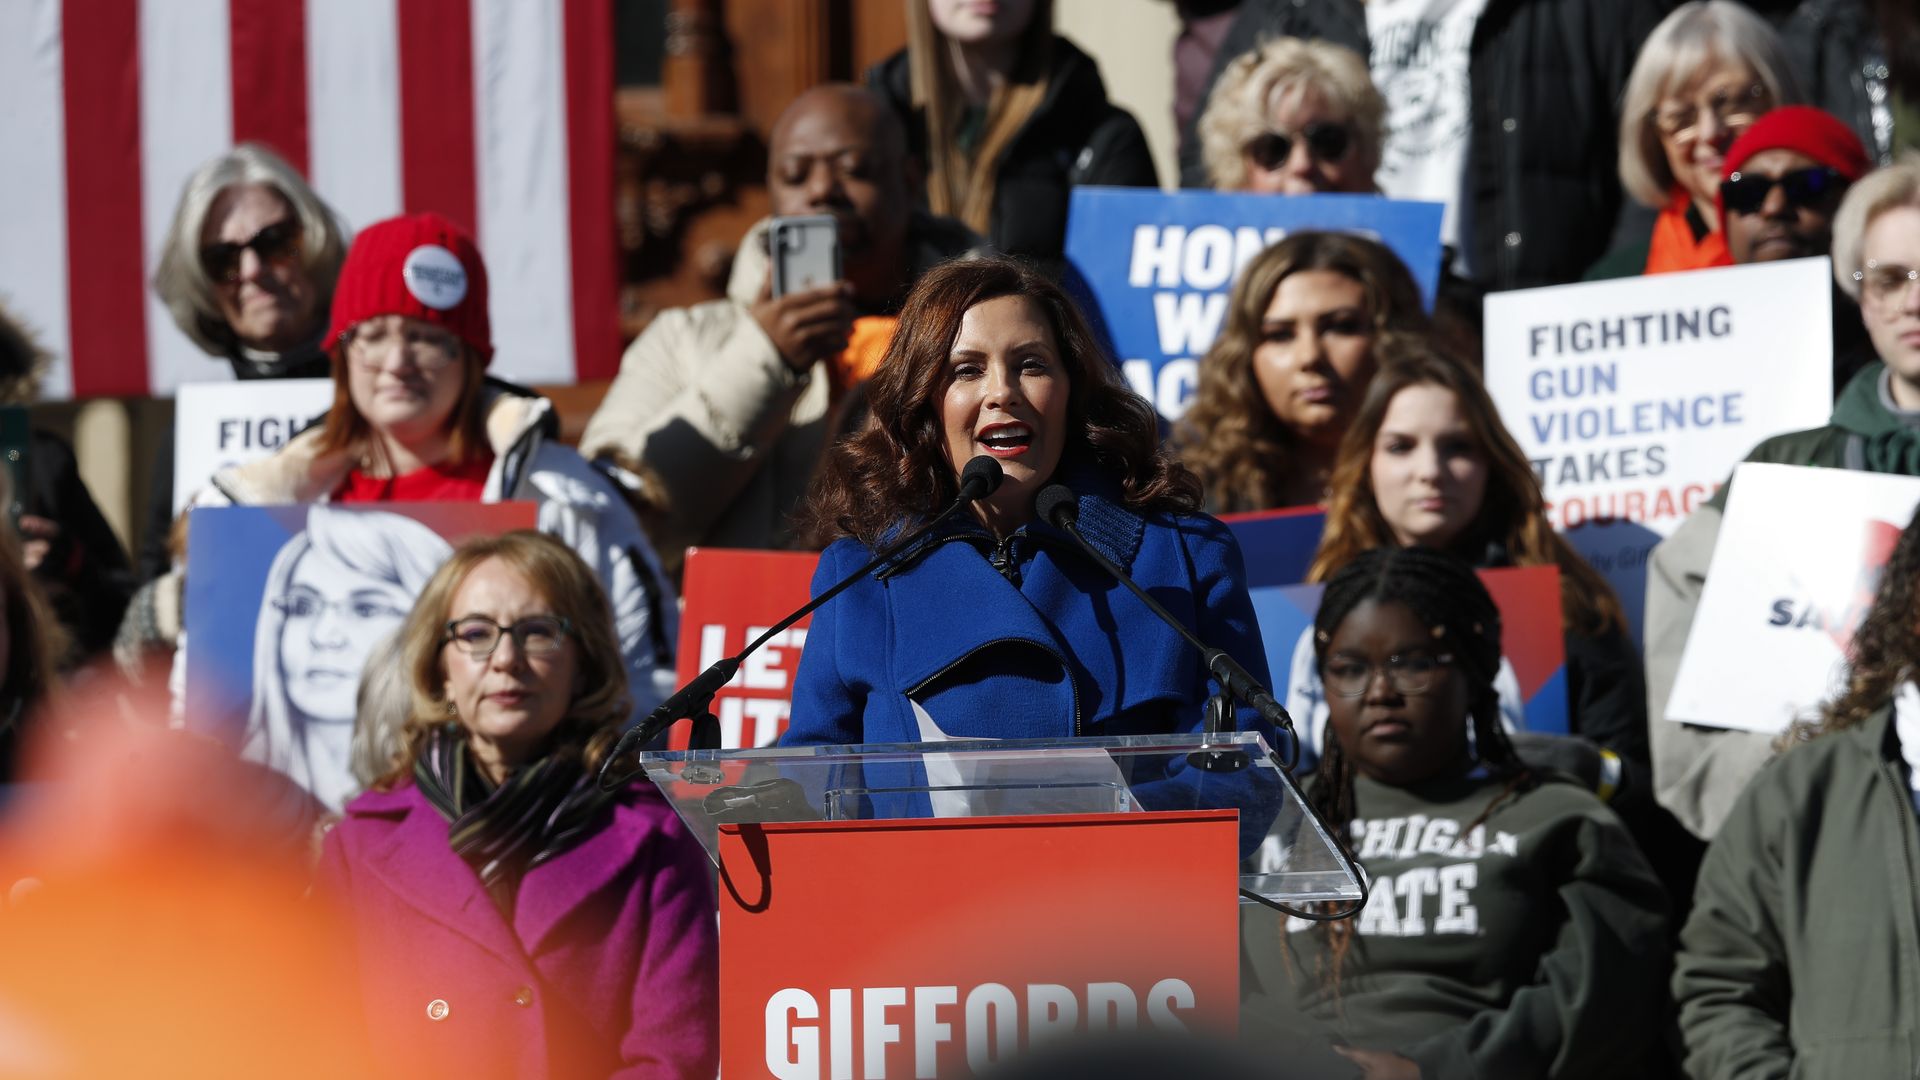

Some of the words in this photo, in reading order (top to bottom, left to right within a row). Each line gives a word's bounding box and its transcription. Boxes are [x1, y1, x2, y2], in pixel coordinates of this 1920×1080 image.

[1529, 305, 1731, 358] FIGHTING
[1530, 362, 1617, 402] GUN
[1531, 393, 1743, 445] VIOLENCE
[1530, 445, 1666, 485] TAKES
[699, 624, 808, 690] LE
